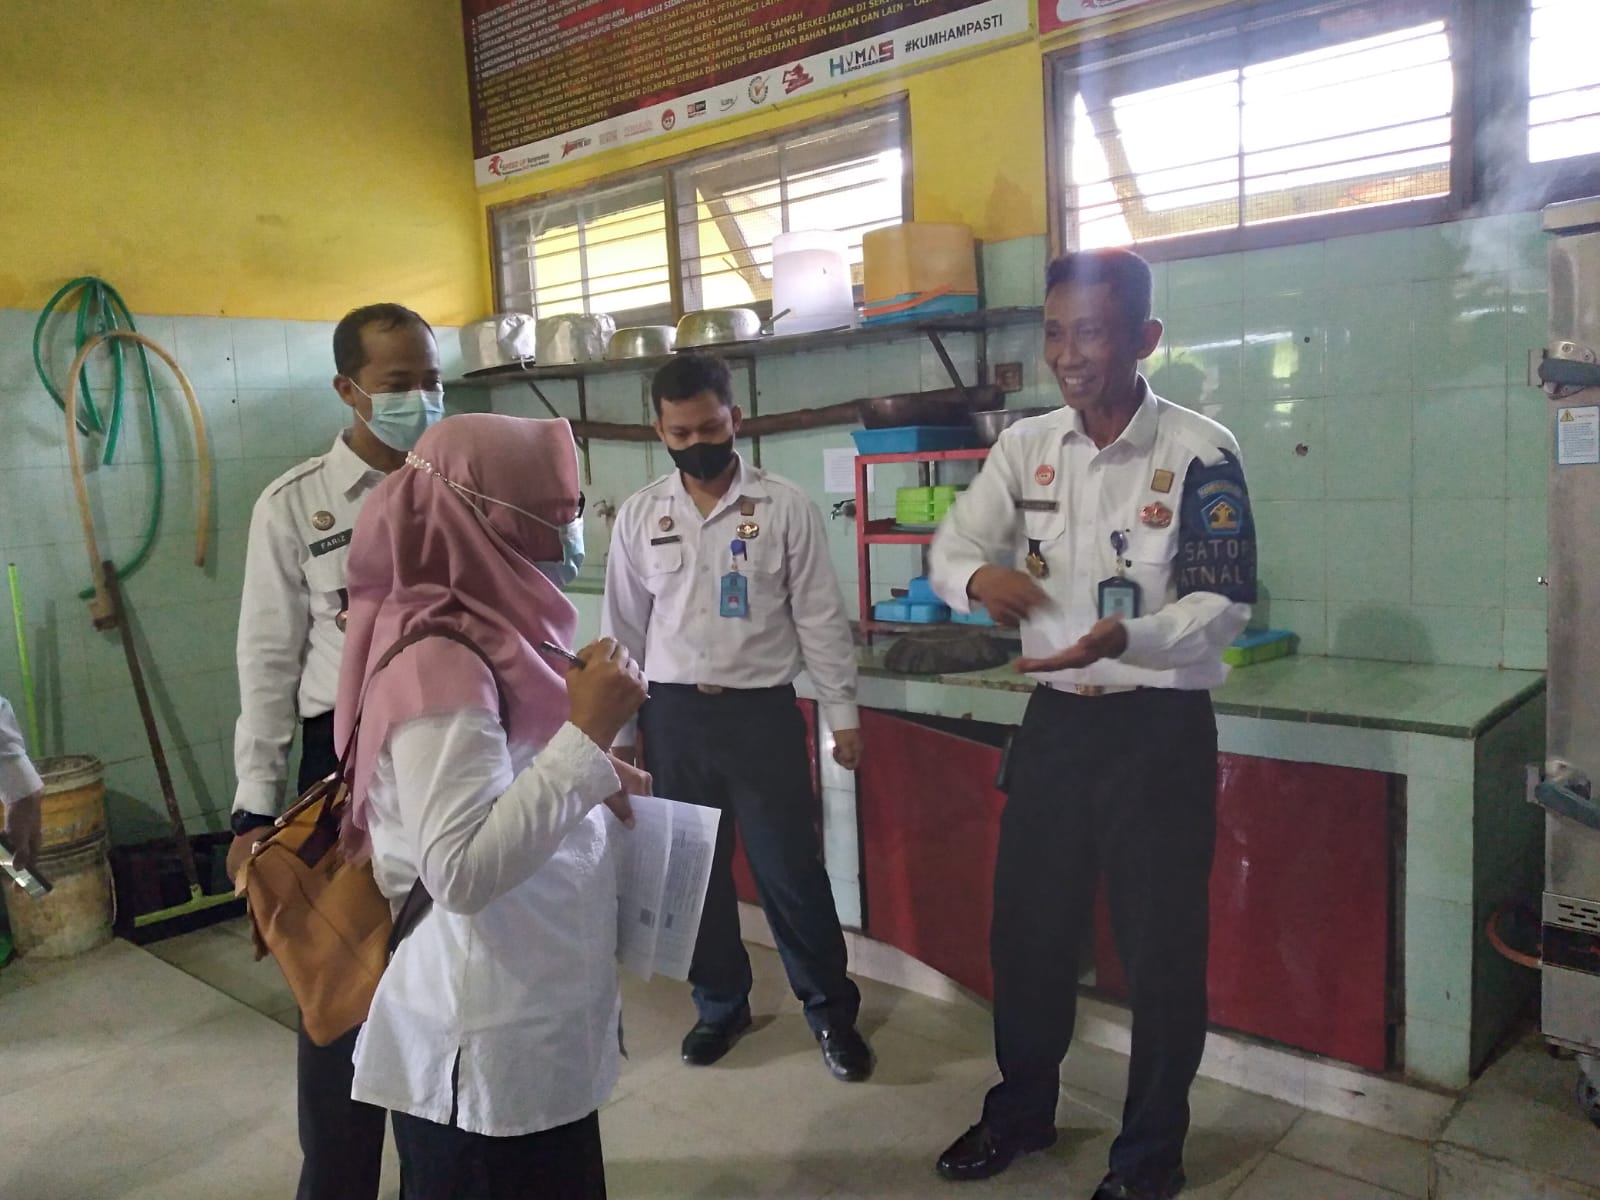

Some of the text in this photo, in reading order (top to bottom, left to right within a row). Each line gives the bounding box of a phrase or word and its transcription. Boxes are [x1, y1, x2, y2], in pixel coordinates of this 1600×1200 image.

[634, 4, 662, 20] MELALUI
[718, 12, 733, 23] DAN
[722, 33, 737, 45] DAN
[740, 23, 768, 39] TEMPAT
[771, 11, 802, 28] SAMPAH
[655, 48, 662, 56] DI
[693, 31, 711, 43] OLEH
[705, 62, 719, 73] DAN
[722, 54, 745, 68] UNTUK
[748, 37, 796, 59] PERSEDIAAN
[799, 27, 826, 43] BAHAN
[829, 17, 858, 33] MAKAN
[861, 10, 878, 23] DAN
[882, 2, 903, 16] LAIN
[710, 43, 744, 60] TAMPING
[746, 34, 771, 48] DAPUR
[774, 26, 795, 39] YANG
[797, 6, 853, 31] BERKELIARAN
[856, 2, 865, 12] DI
[905, 13, 1003, 53] #KUMHAMPASTI
